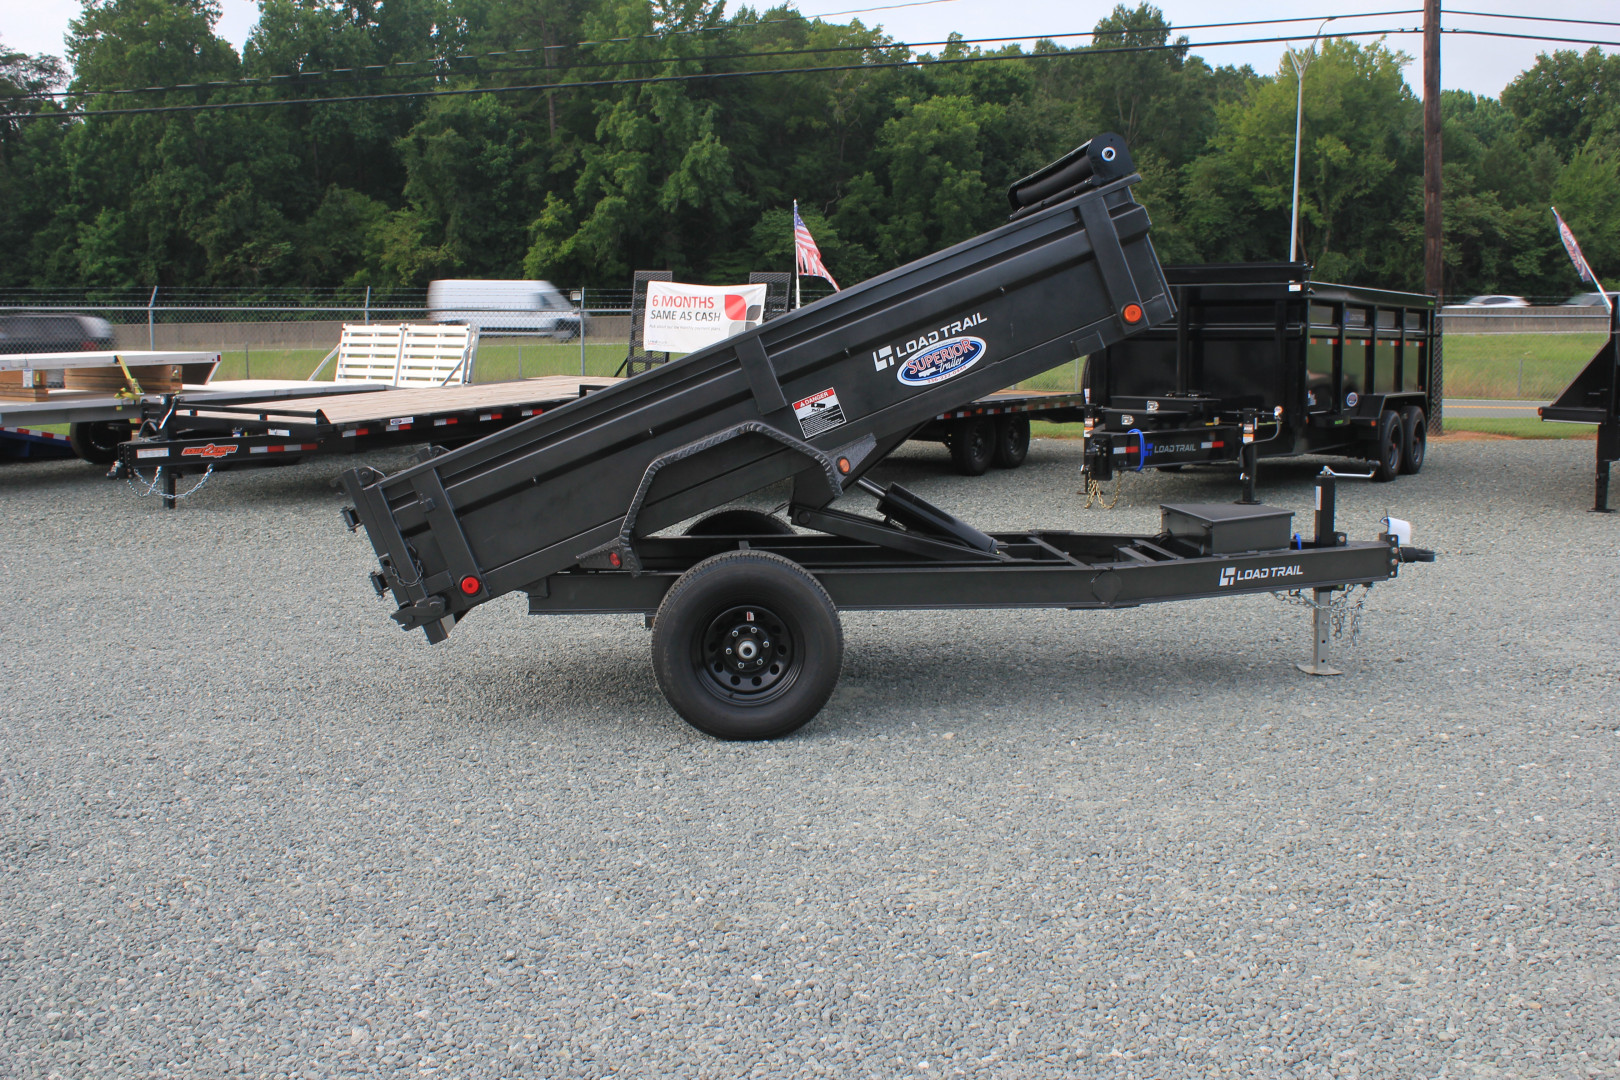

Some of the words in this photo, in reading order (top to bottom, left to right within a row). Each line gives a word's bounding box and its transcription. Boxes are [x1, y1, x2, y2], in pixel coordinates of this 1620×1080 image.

[652, 295, 659, 307] 6
[661, 295, 714, 309] MONTHS
[650, 310, 677, 321] SAME
[680, 311, 692, 321] AS
[695, 312, 721, 322] CASH
[896, 330, 939, 358] LOAD
[940, 312, 988, 338] TRAIL
[906, 338, 975, 375] SUPERIOR
[804, 391, 829, 406] DANGER
[1154, 445, 1175, 454] LOAD
[1175, 443, 1197, 452] TRAIL
[1237, 568, 1270, 581] LOAD
[1270, 565, 1304, 578] TRAIL
